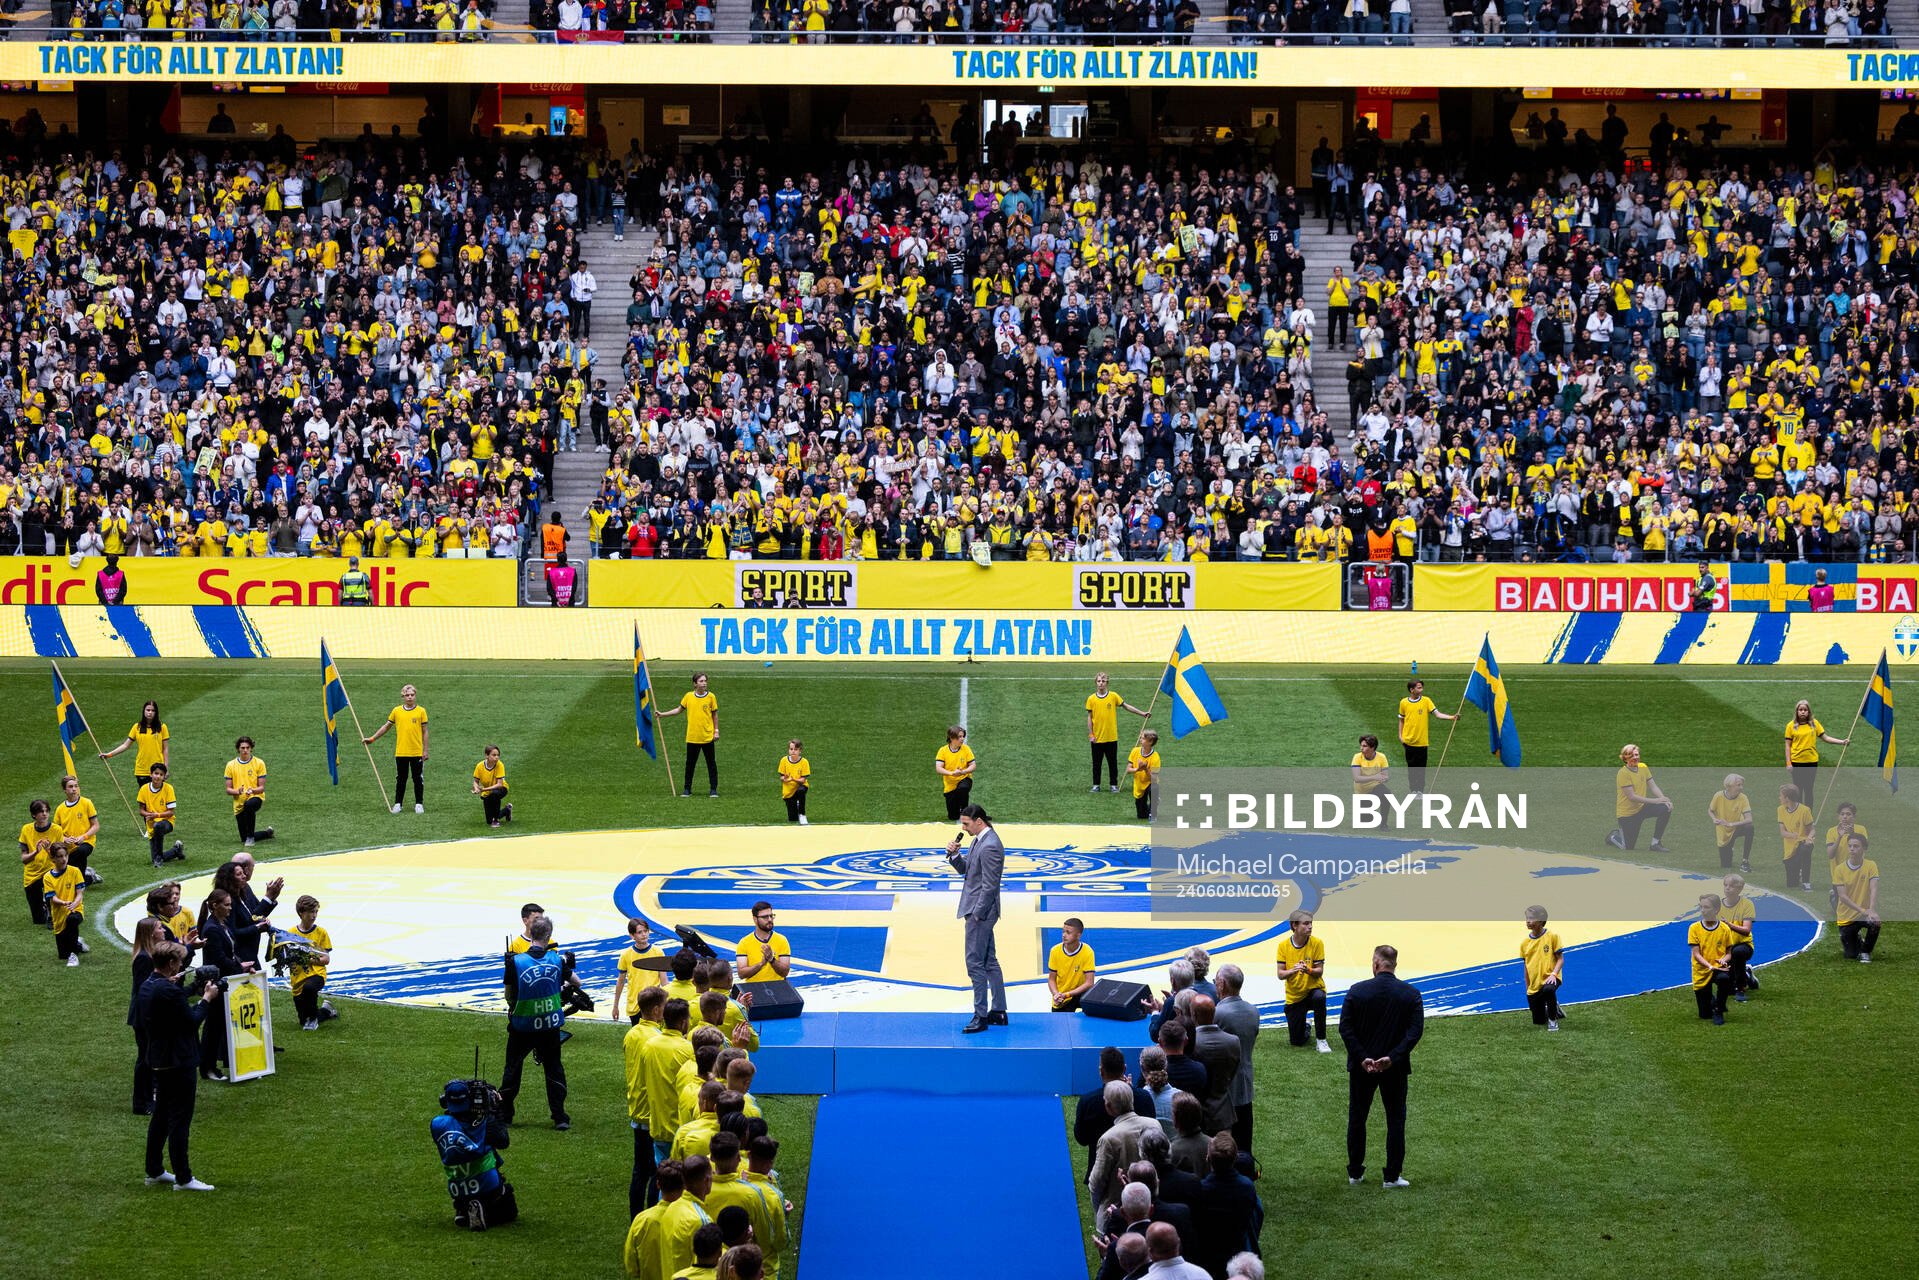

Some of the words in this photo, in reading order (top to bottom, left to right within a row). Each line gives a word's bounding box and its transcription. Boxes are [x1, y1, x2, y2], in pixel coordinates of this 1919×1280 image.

[39, 46, 105, 74] TACK
[113, 45, 161, 75] FÖR
[169, 47, 227, 75] ALLT
[235, 47, 343, 75] ZLATAN!
[953, 50, 1019, 79] TACK
[1027, 49, 1075, 79] FÖR
[1083, 51, 1141, 79] ALLT
[1149, 51, 1257, 79] ZLATAN!
[1784, 421, 1794, 435] 10
[1, 564, 86, 605] dic
[741, 569, 853, 606] SPORT
[1080, 571, 1191, 608] SPORT
[1856, 583, 1911, 610] BA
[701, 617, 789, 655] TACK
[796, 615, 862, 655] FÖR
[869, 618, 947, 656] ALLT
[953, 618, 1092, 656] ZLATAN!
[522, 967, 558, 984] UEFA
[534, 999, 554, 1013] HB
[534, 1013, 560, 1030] 019
[450, 1179, 480, 1197] 019
